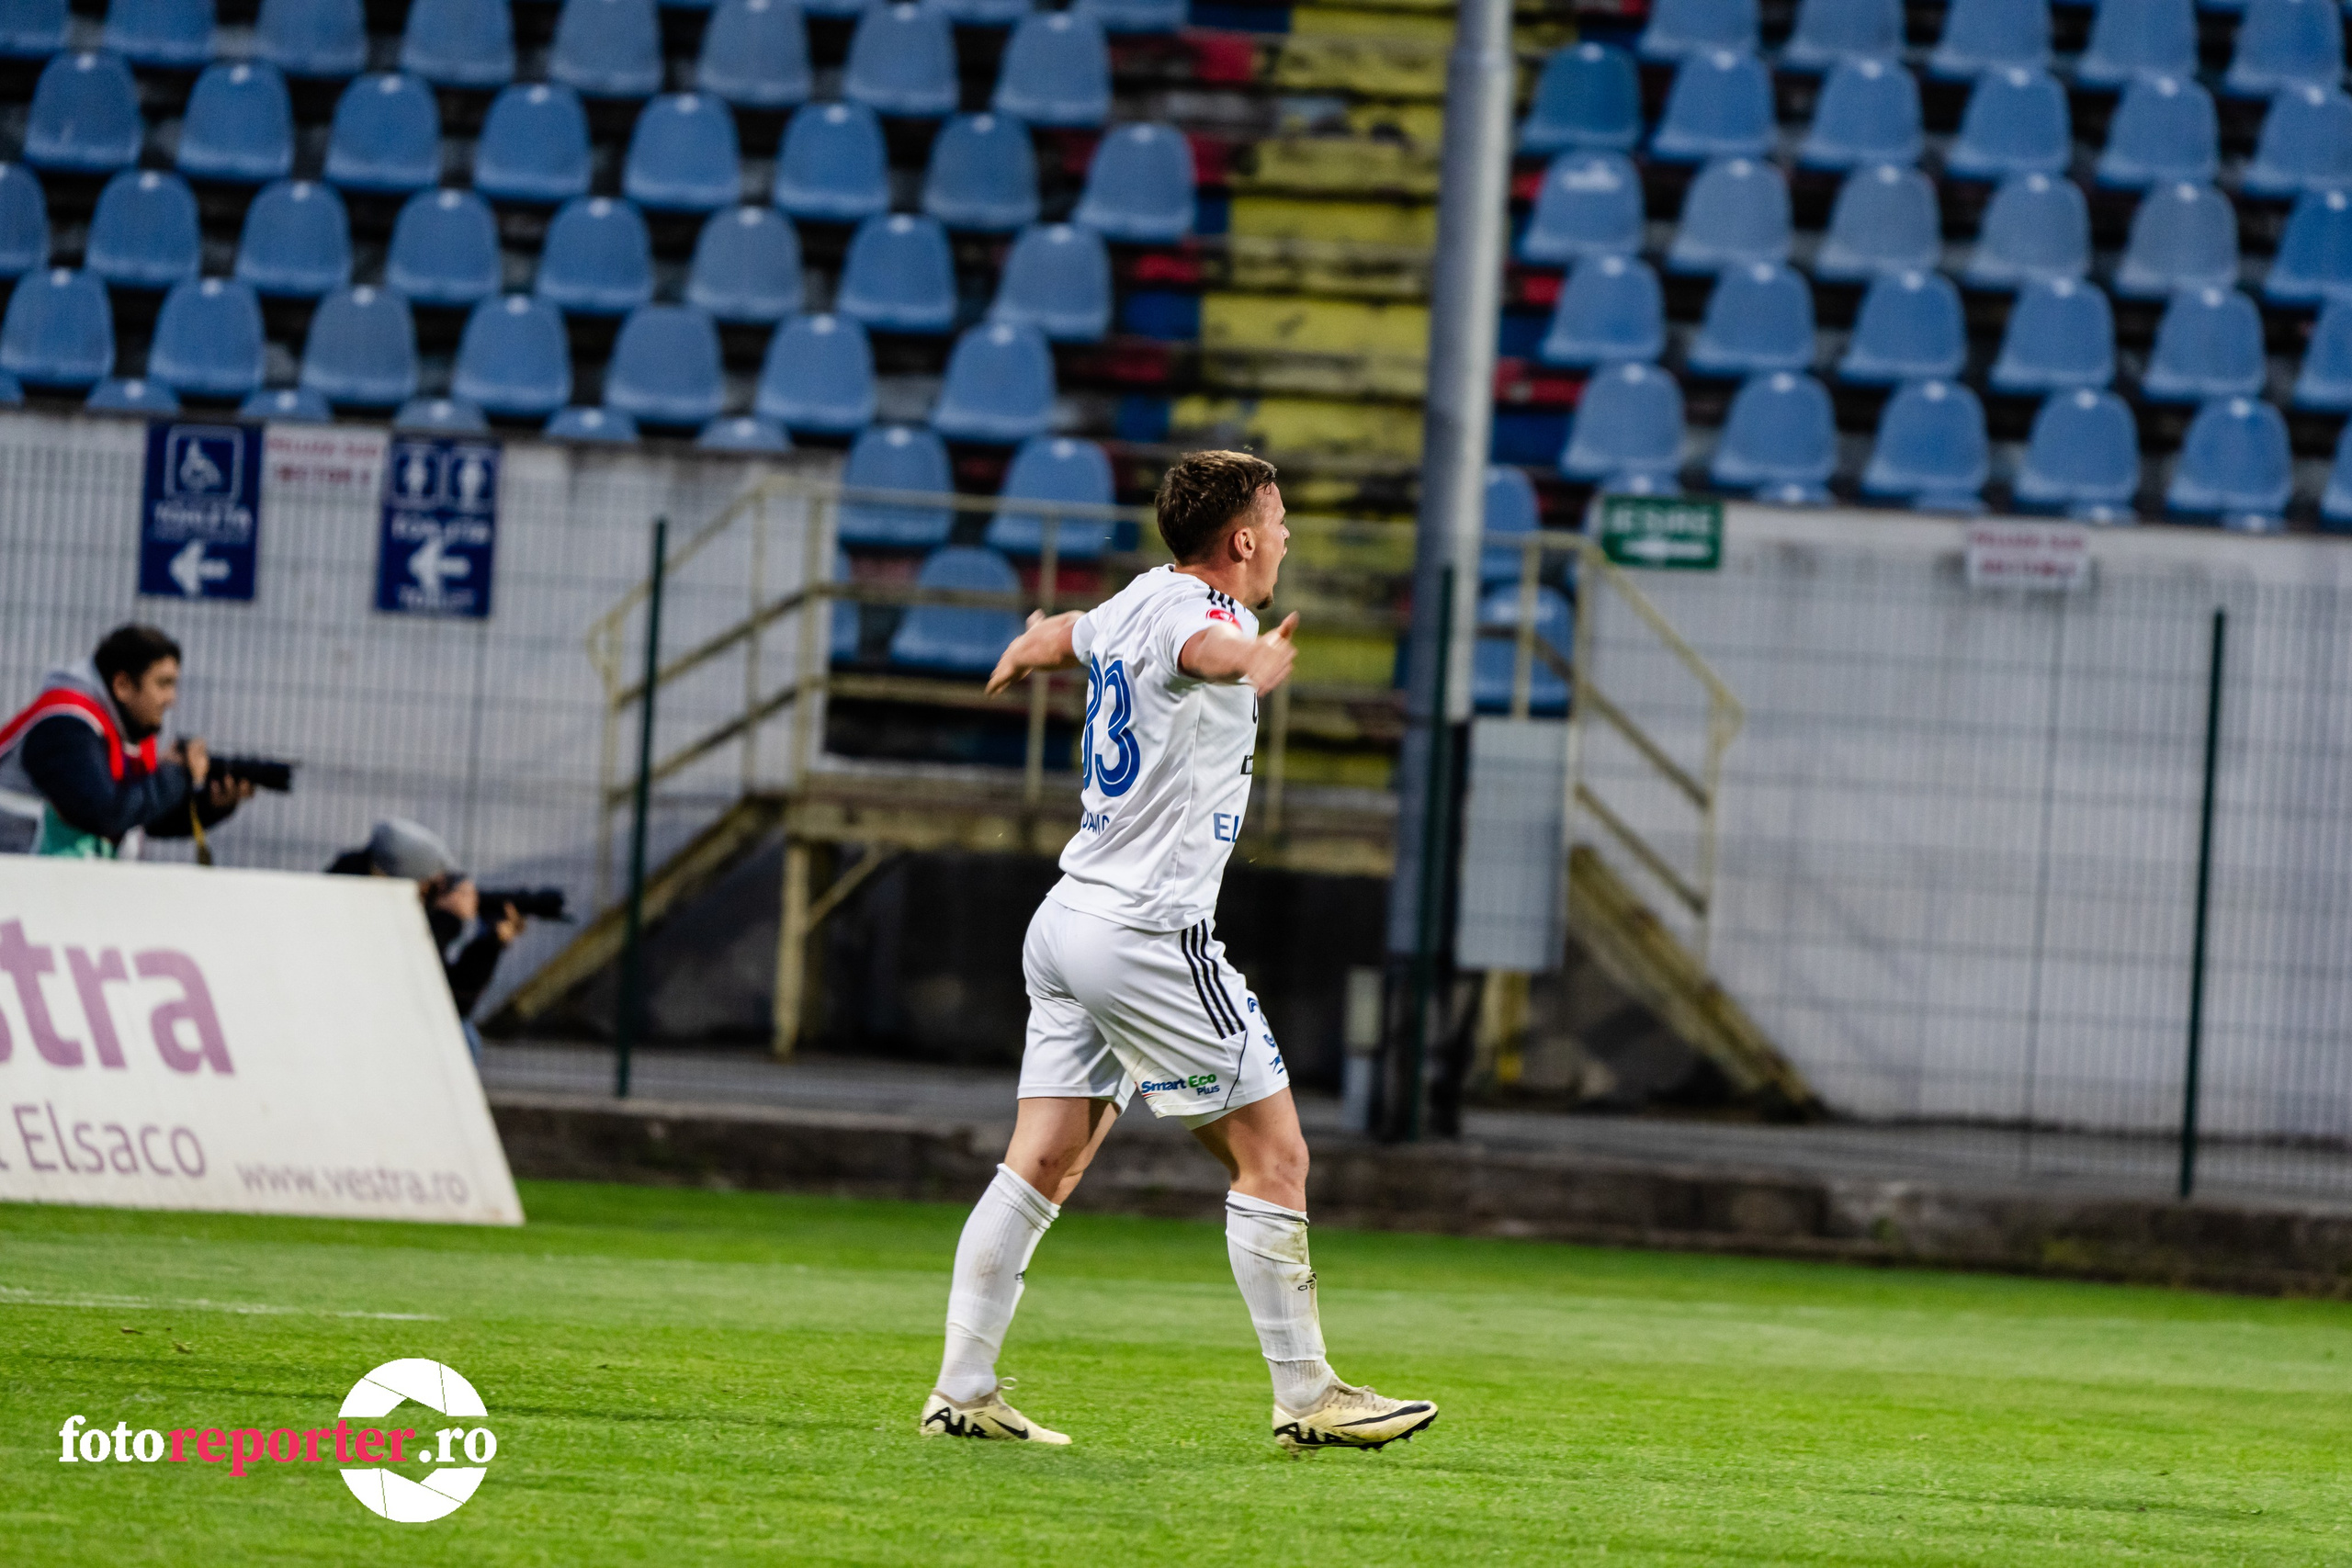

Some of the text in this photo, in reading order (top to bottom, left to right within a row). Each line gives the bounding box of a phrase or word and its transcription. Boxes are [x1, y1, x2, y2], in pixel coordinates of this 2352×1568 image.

[0, 917, 235, 1076] tra
[1141, 1074, 1217, 1093] Smart Eco
[1196, 1084, 1221, 1096] Plus
[12, 1100, 206, 1178] Elsaco
[234, 1161, 470, 1206] www.vestra.ro
